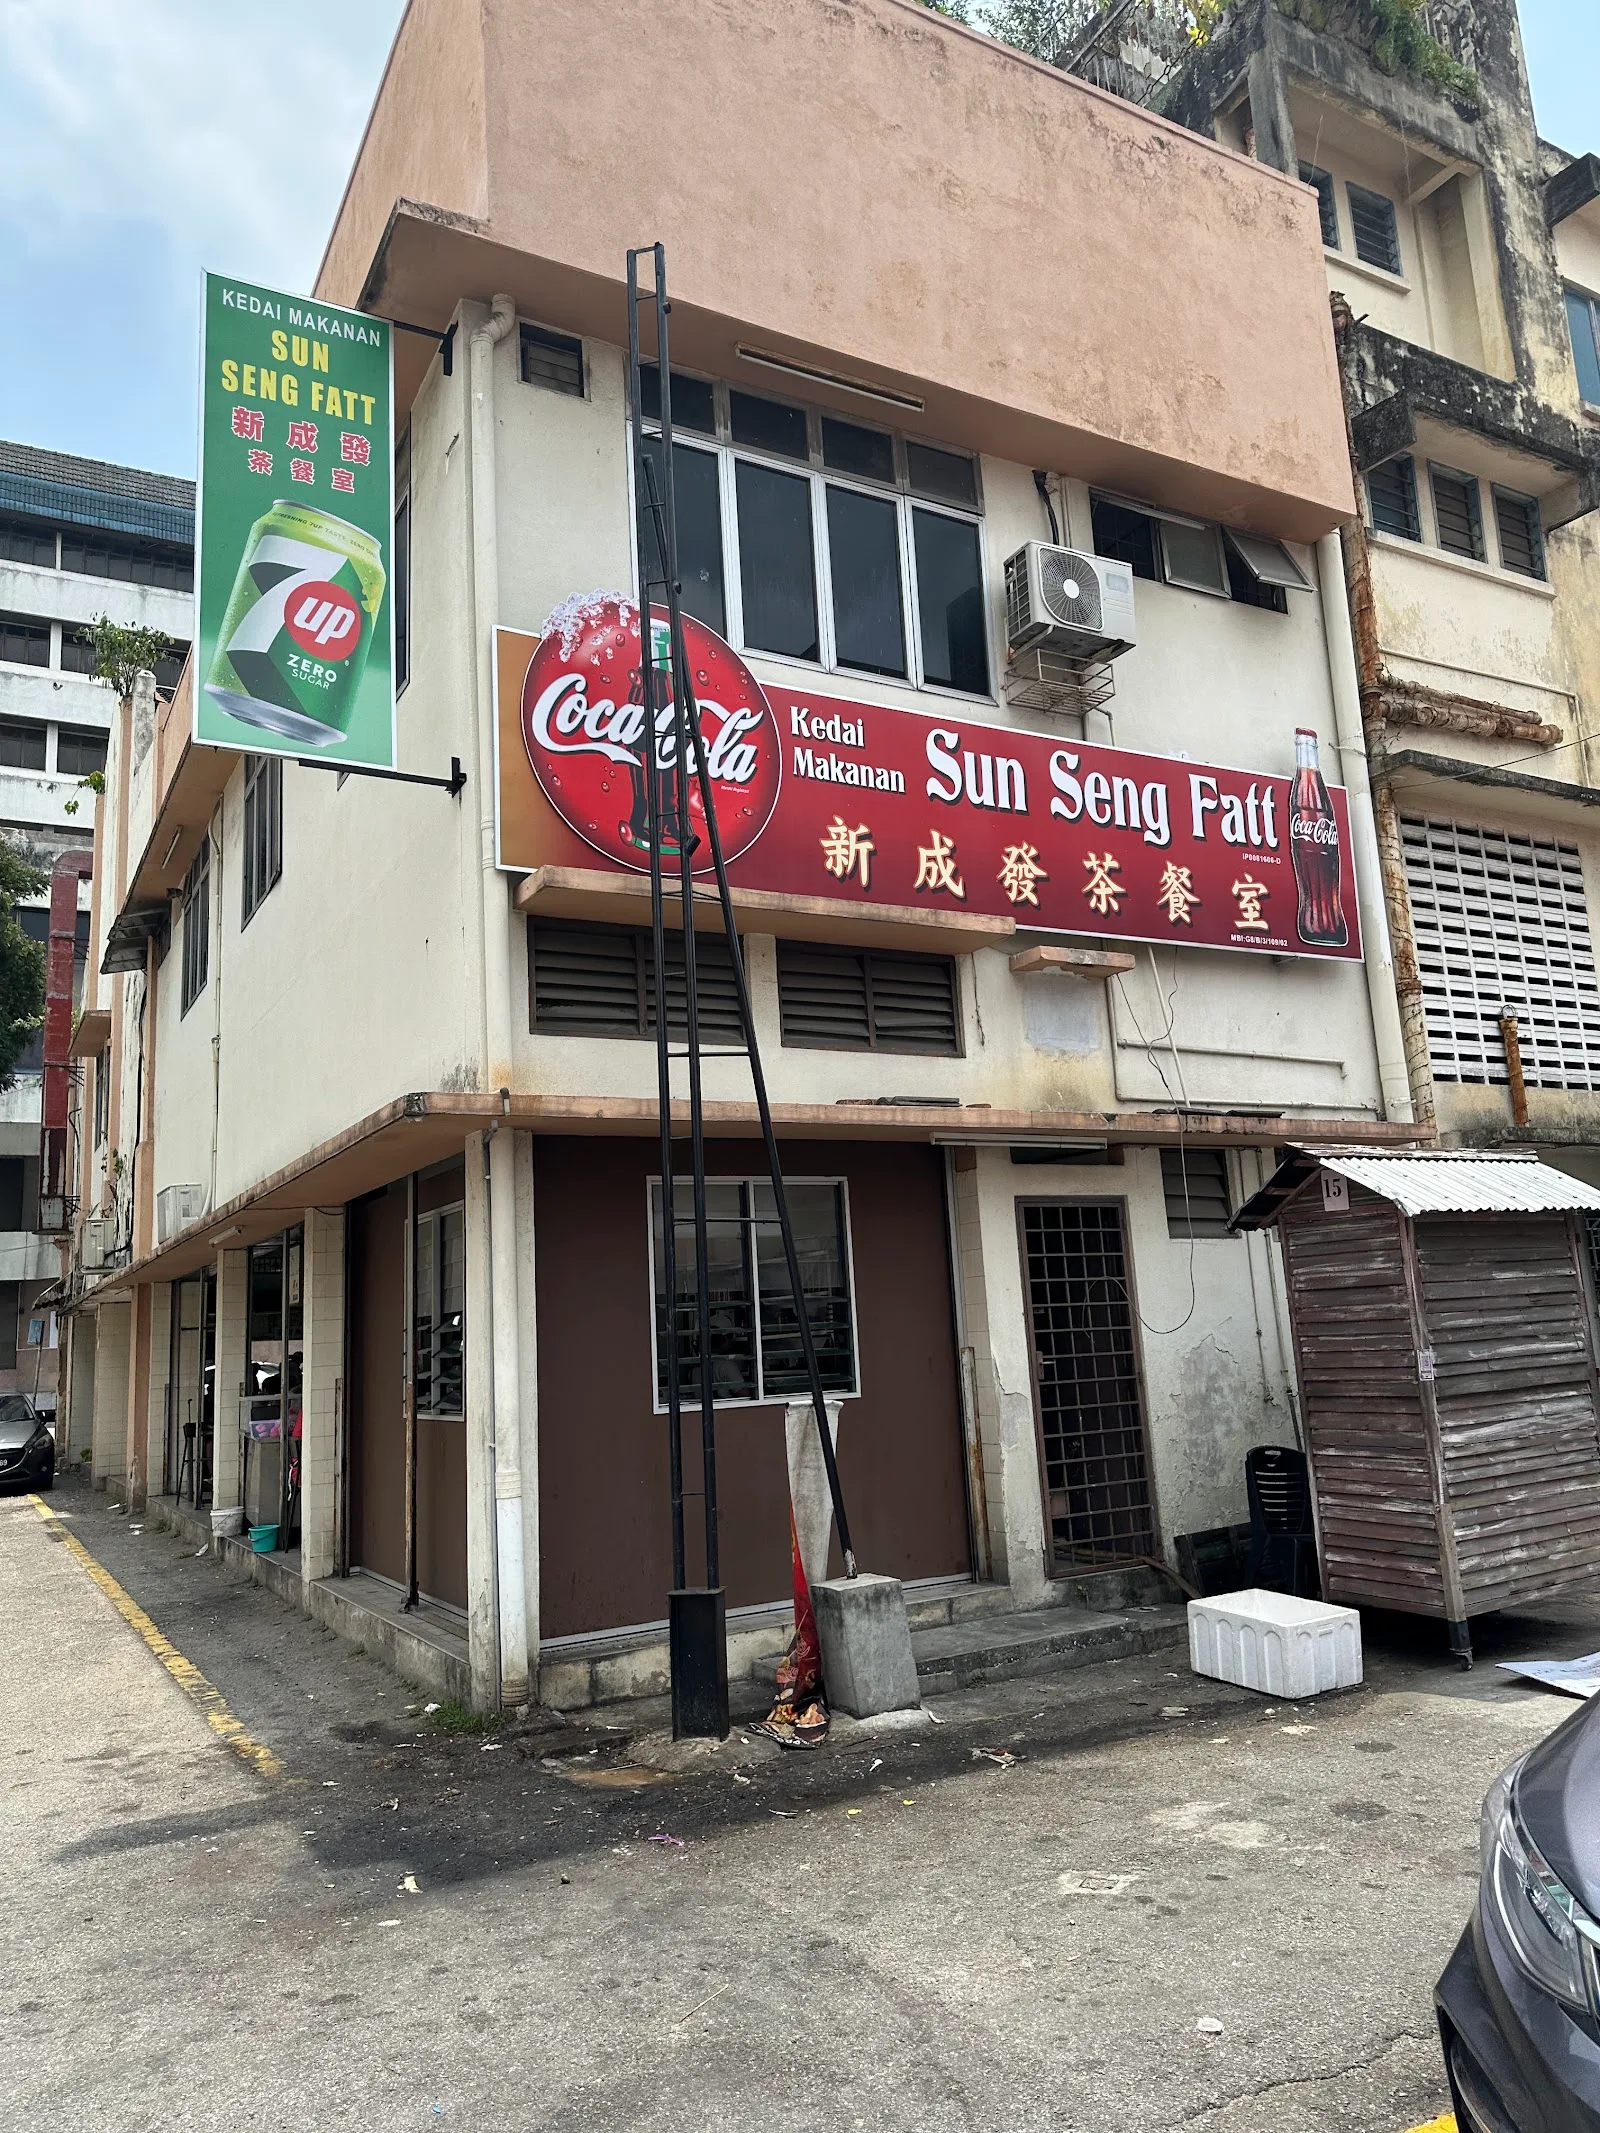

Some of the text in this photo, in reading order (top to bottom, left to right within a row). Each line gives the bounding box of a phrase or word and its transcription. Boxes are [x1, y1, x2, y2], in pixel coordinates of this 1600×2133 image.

[223, 289, 380, 347] KEDAI MAKANAN
[271, 329, 329, 373] SUN
[221, 359, 376, 425] SENG FATT
[231, 405, 371, 466] 新成發
[248, 449, 355, 493] 茶餐室
[286, 653, 337, 683] ZERO
[291, 668, 330, 690] SUGAR
[790, 705, 865, 748] Kedai
[793, 746, 906, 794] Makanan
[926, 728, 1279, 848] Sun Seng Fatt
[1291, 812, 1337, 845] Coca-Cola
[819, 815, 1269, 931] 新成發茶餐室
[1323, 1178, 1342, 1199] 15
